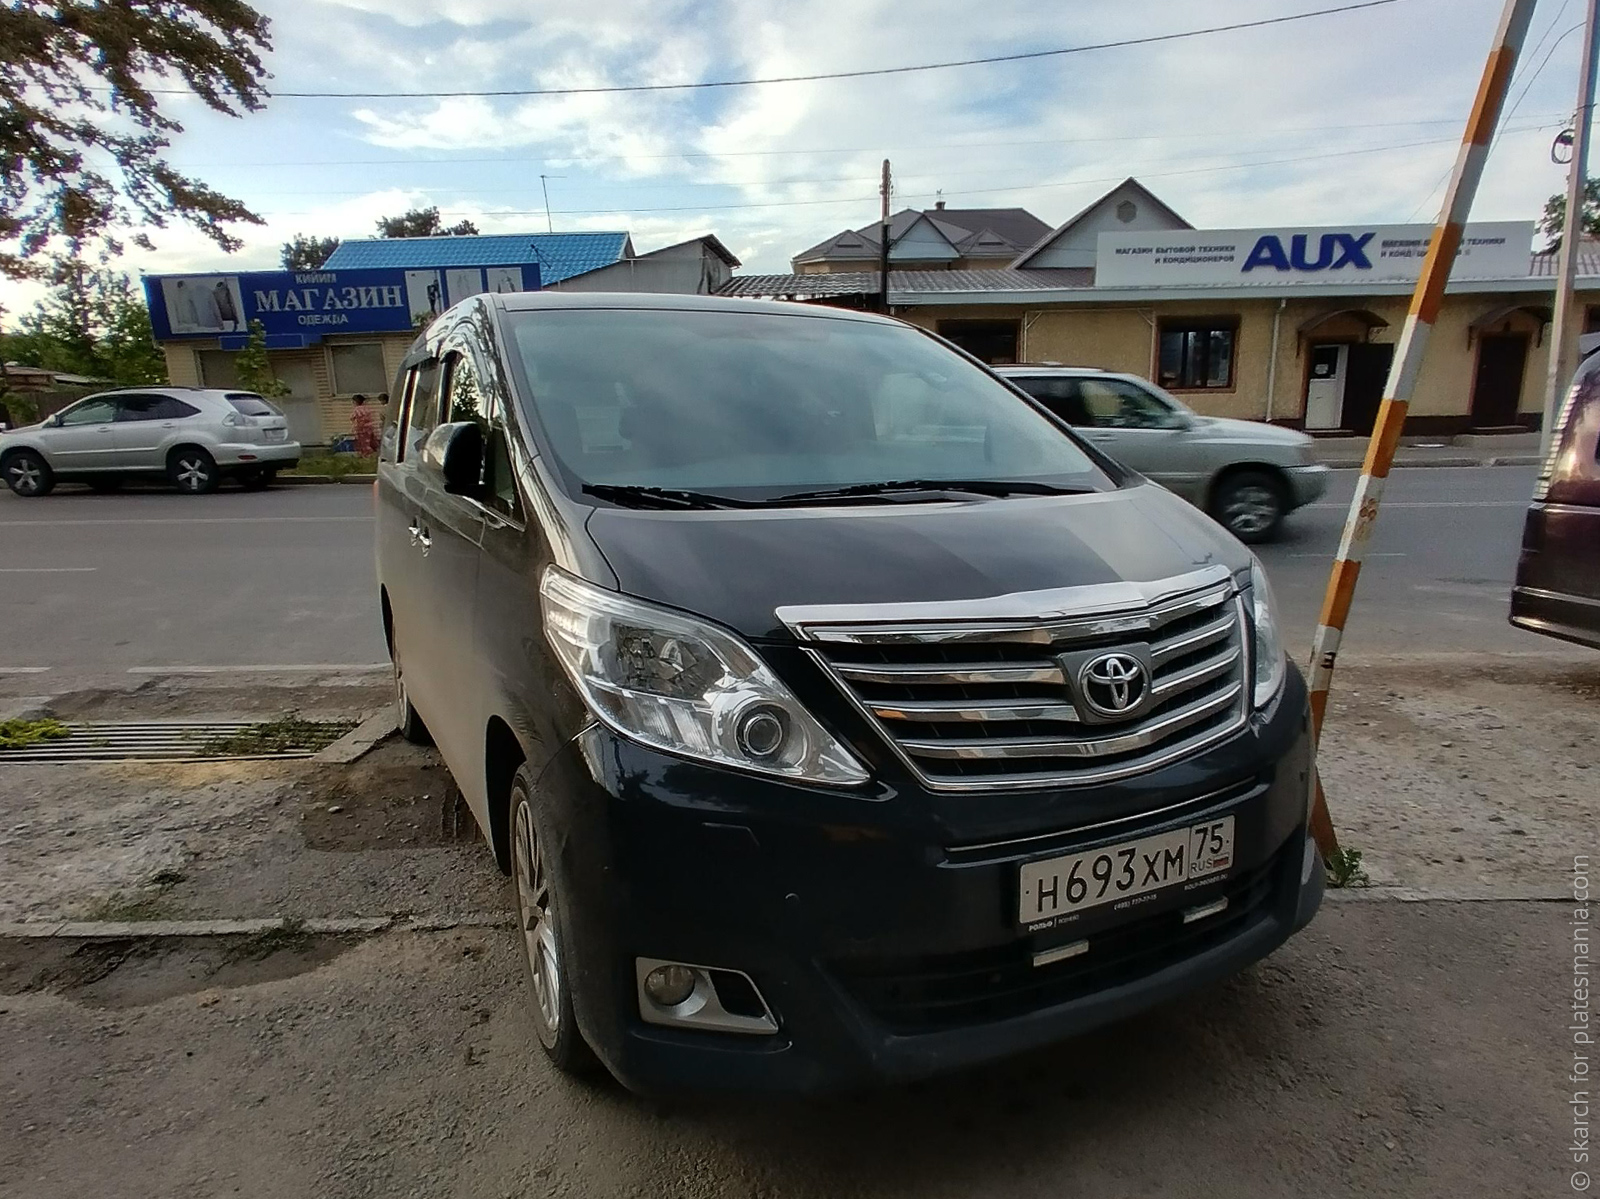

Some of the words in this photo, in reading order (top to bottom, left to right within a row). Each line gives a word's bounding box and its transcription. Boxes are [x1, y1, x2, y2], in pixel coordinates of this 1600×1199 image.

[1467, 238, 1506, 246] ТЕХНИКИ
[1115, 247, 1153, 255] МАГАЗИН
[1155, 245, 1195, 254] БЫТОВОЙ
[1199, 245, 1236, 253] ТЕХНИКИ
[1241, 232, 1377, 273] AUX
[1163, 255, 1235, 264] КОНДИЦИОНЕРОВ
[254, 286, 404, 312] МАГАЗИН
[298, 314, 348, 326] ОДЕЖДА
[1037, 844, 1185, 913] Н693ХМ
[1194, 823, 1225, 860] 75
[1191, 859, 1213, 873] RUS
